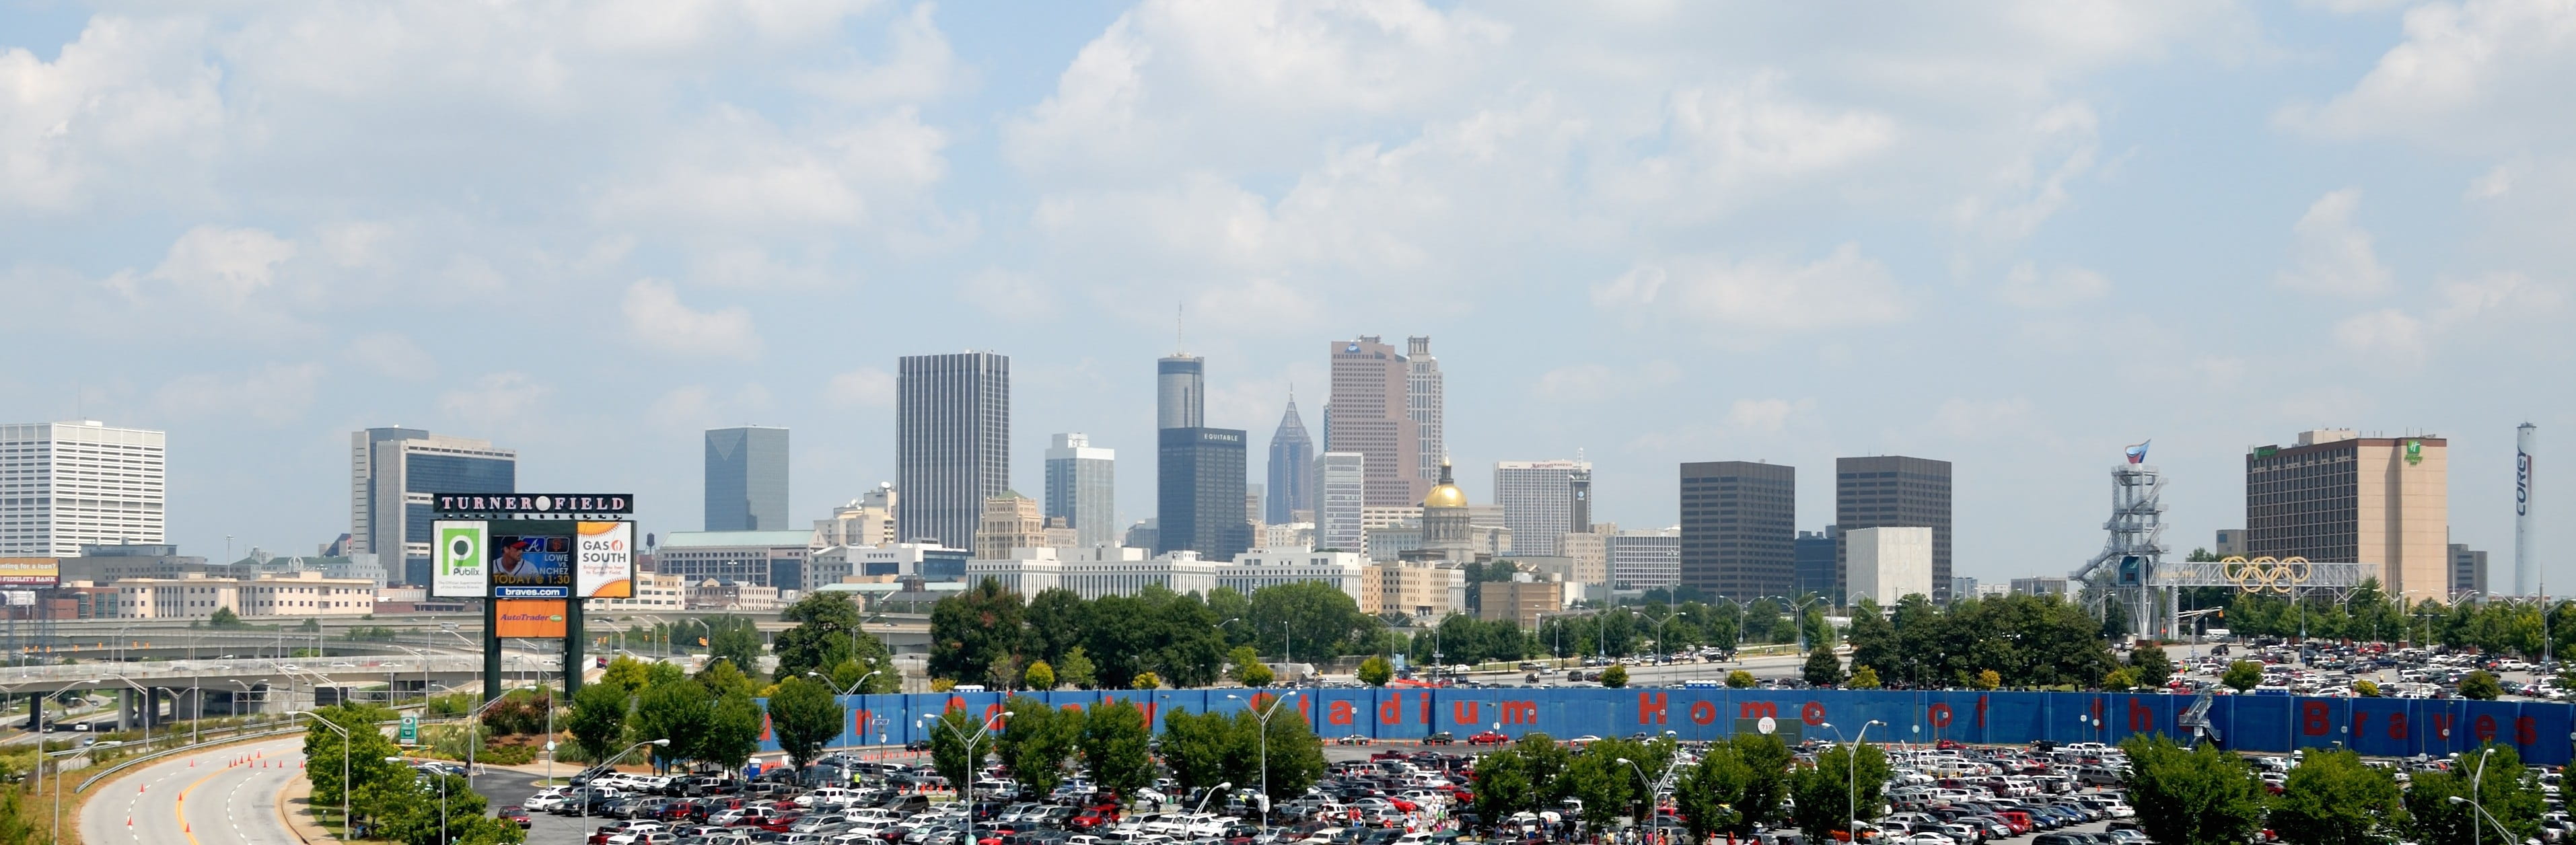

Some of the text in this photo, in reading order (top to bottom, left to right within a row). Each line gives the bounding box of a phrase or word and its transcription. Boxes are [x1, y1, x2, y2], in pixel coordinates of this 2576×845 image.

[1205, 433, 1238, 441] EQUITABLE
[2517, 444, 2526, 516] COREY
[441, 497, 624, 510] TURNER FIELD
[583, 541, 609, 550] GAS
[583, 553, 626, 562] SOUTH
[493, 575, 532, 584] TODAY
[548, 575, 570, 584] 1:30
[505, 587, 560, 596] braves.com
[1639, 692, 1826, 727] Home
[1927, 695, 1989, 729] of
[2302, 700, 2537, 745] Braves
